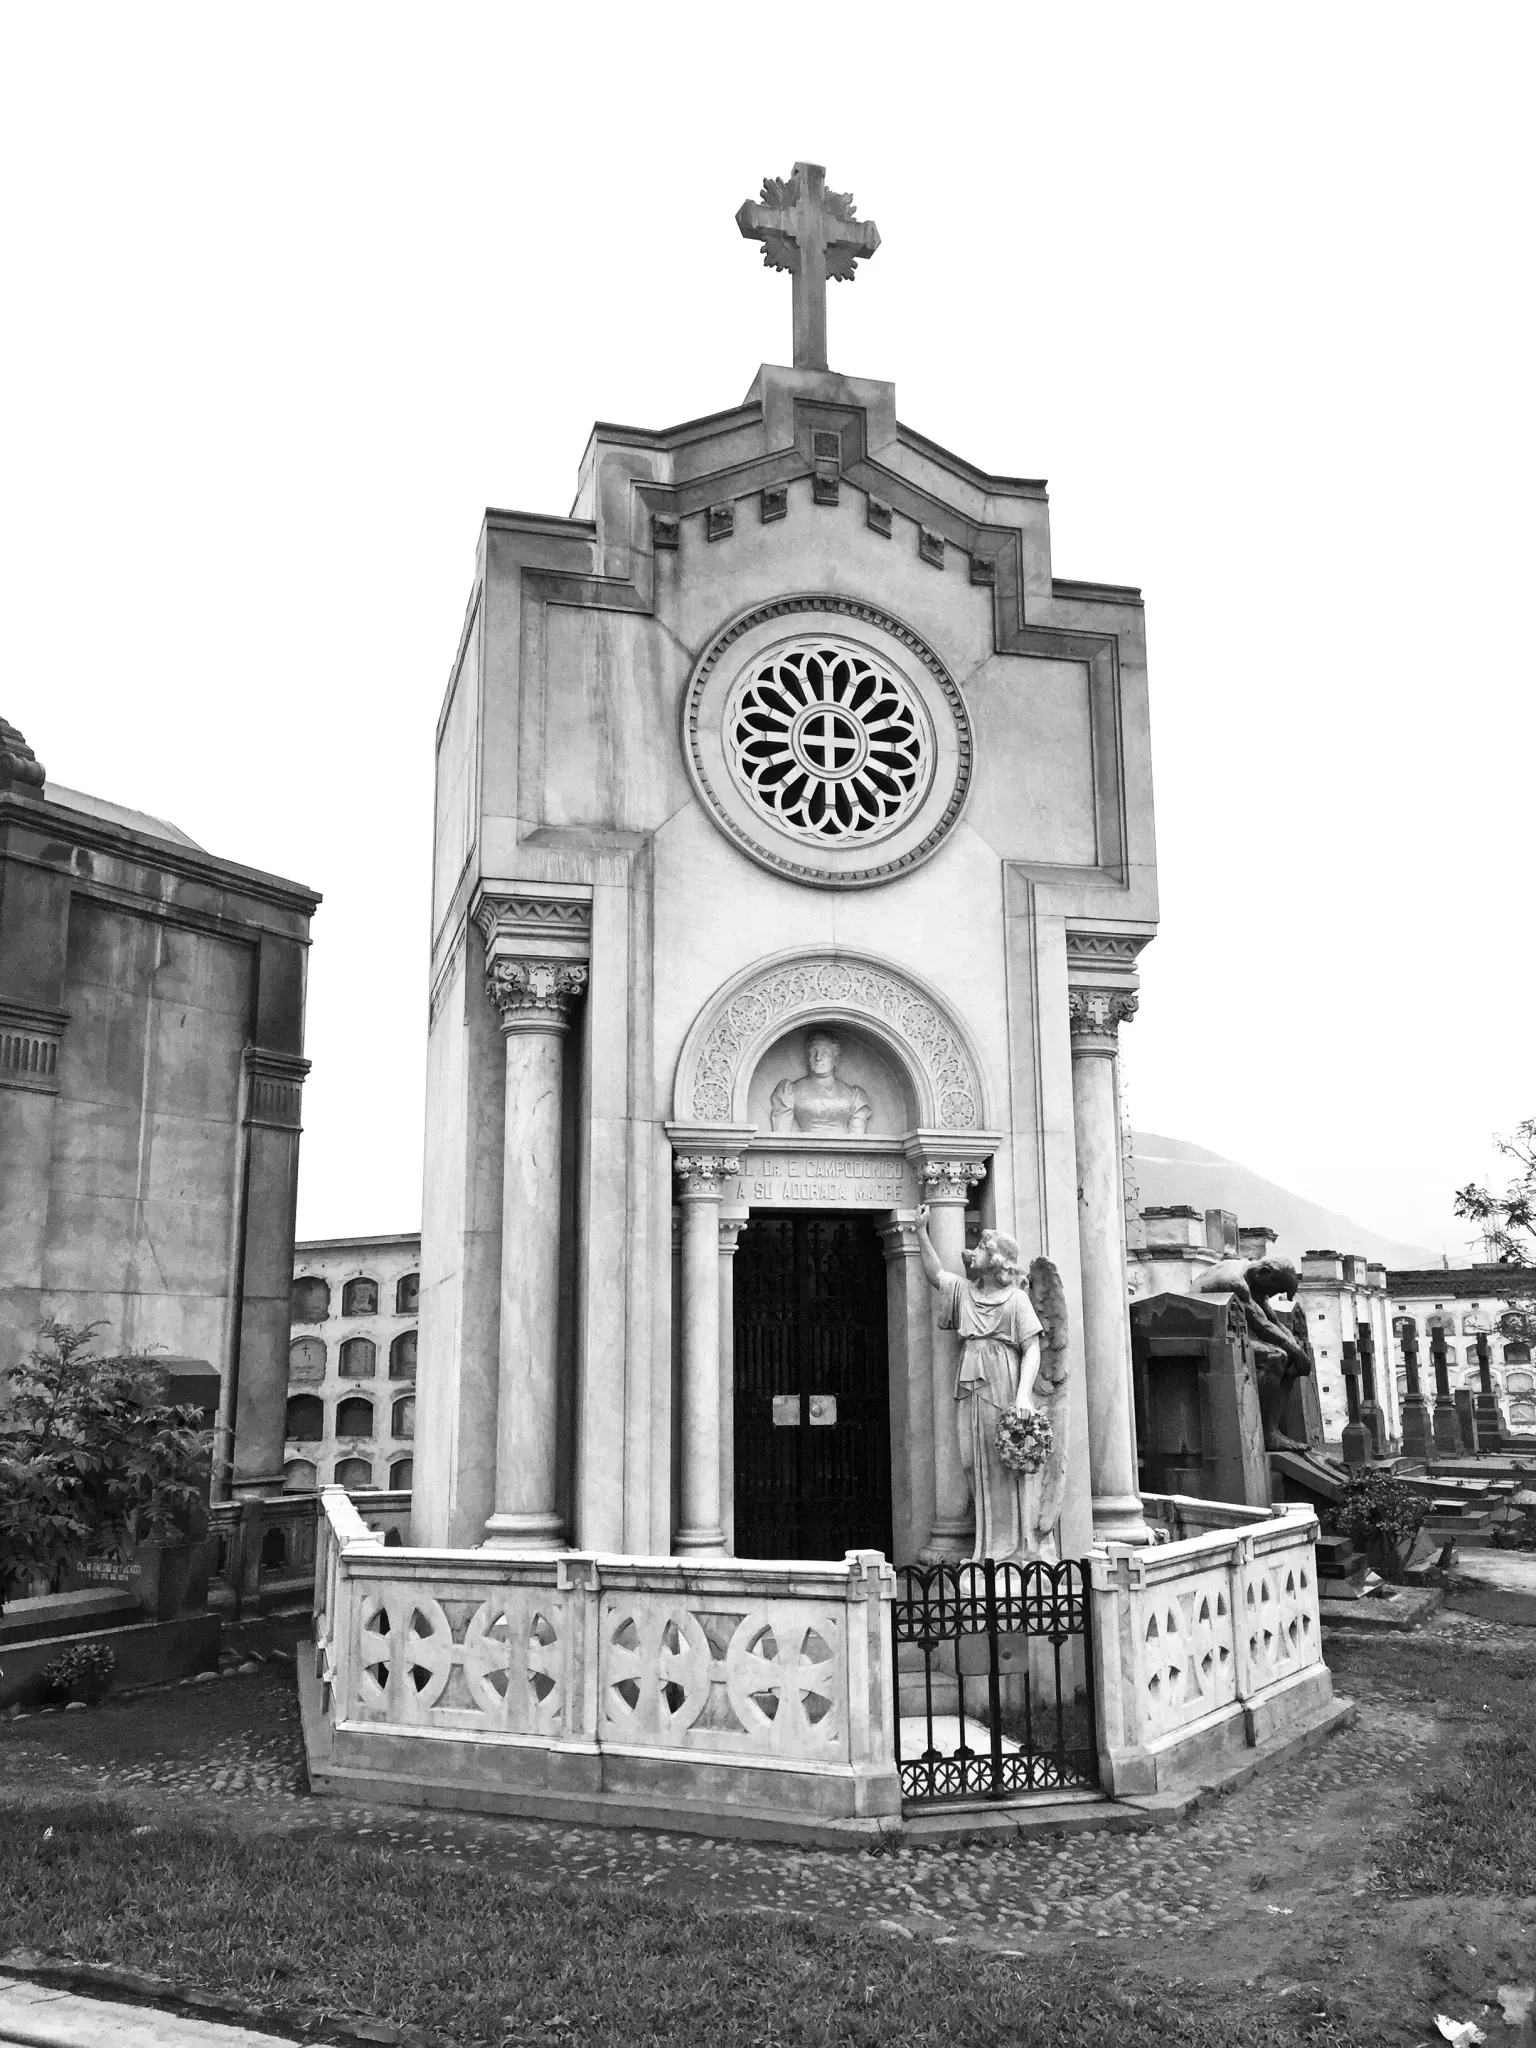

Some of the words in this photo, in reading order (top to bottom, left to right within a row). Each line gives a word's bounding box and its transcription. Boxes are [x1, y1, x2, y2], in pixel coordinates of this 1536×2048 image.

[806, 1160, 903, 1179] CAMPODONICO
[736, 1181, 745, 1199] A
[755, 1181, 772, 1200] SU
[782, 1183, 847, 1201] ADORADA
[855, 1184, 903, 1201] MADRE
